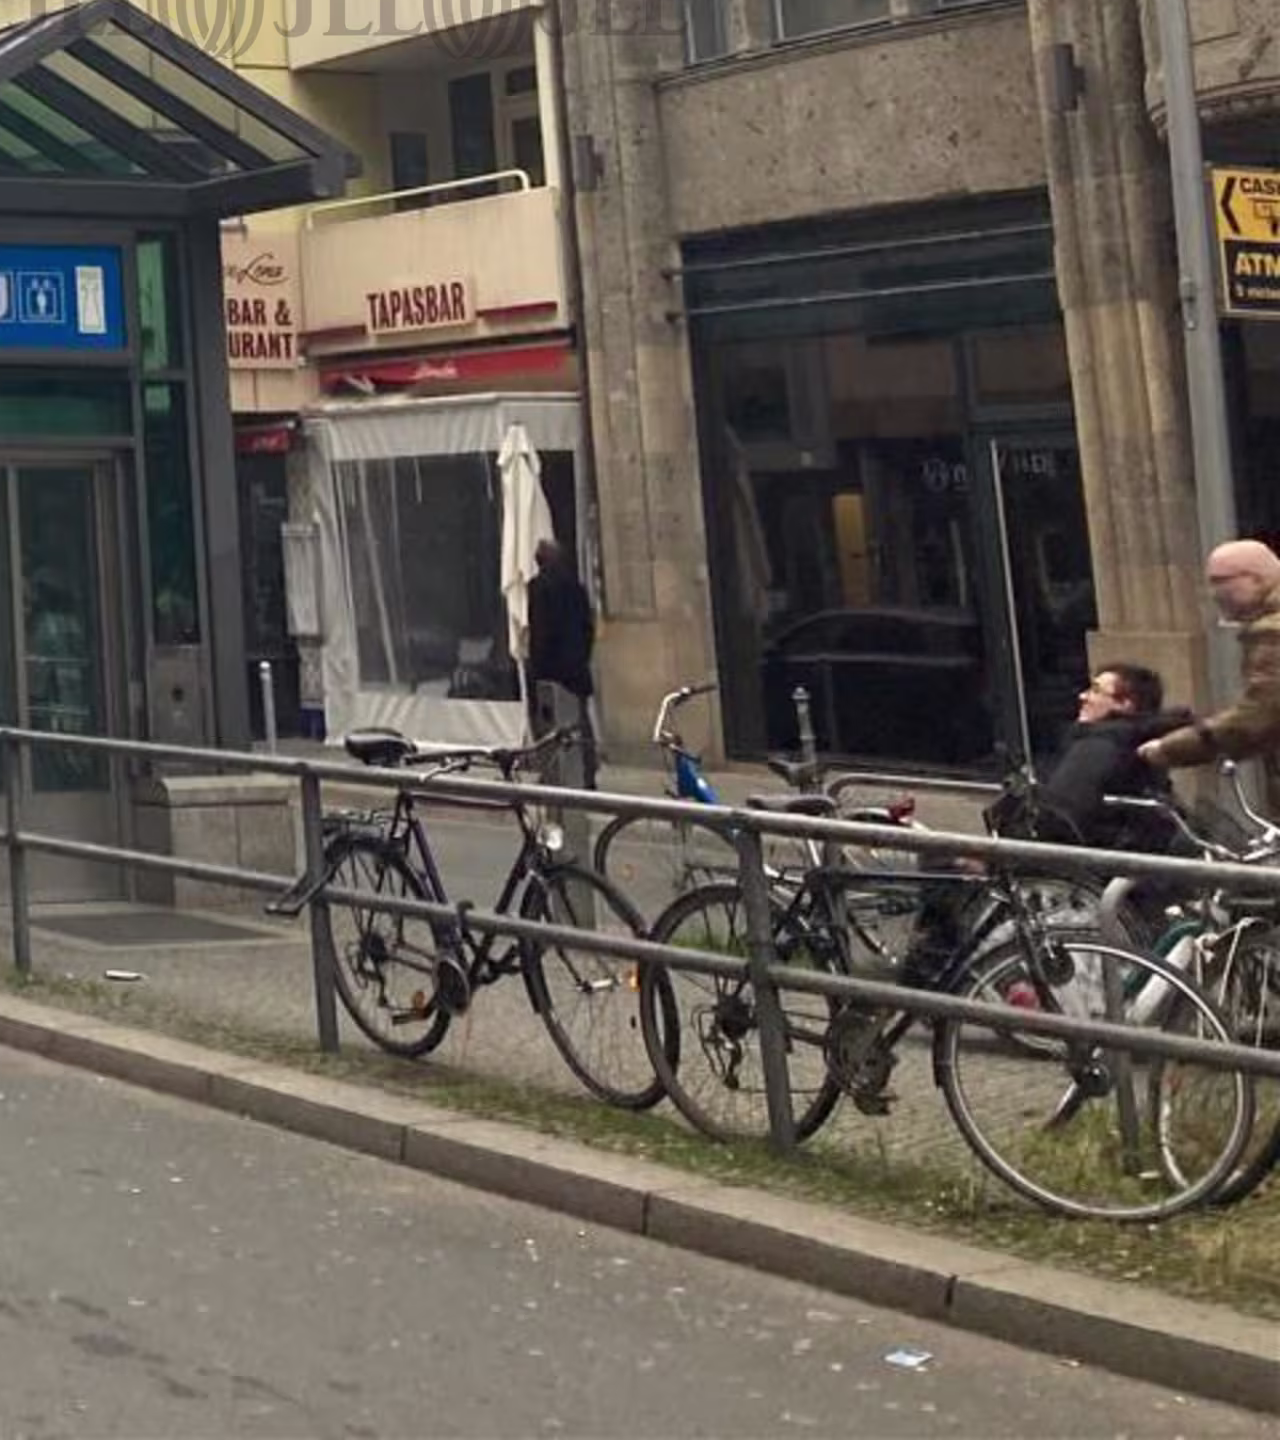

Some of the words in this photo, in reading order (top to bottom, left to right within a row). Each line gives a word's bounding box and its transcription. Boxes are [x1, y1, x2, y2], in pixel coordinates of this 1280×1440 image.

[226, 298, 267, 326] BAR
[274, 299, 293, 326] &
[365, 281, 466, 331] TAPASBAR
